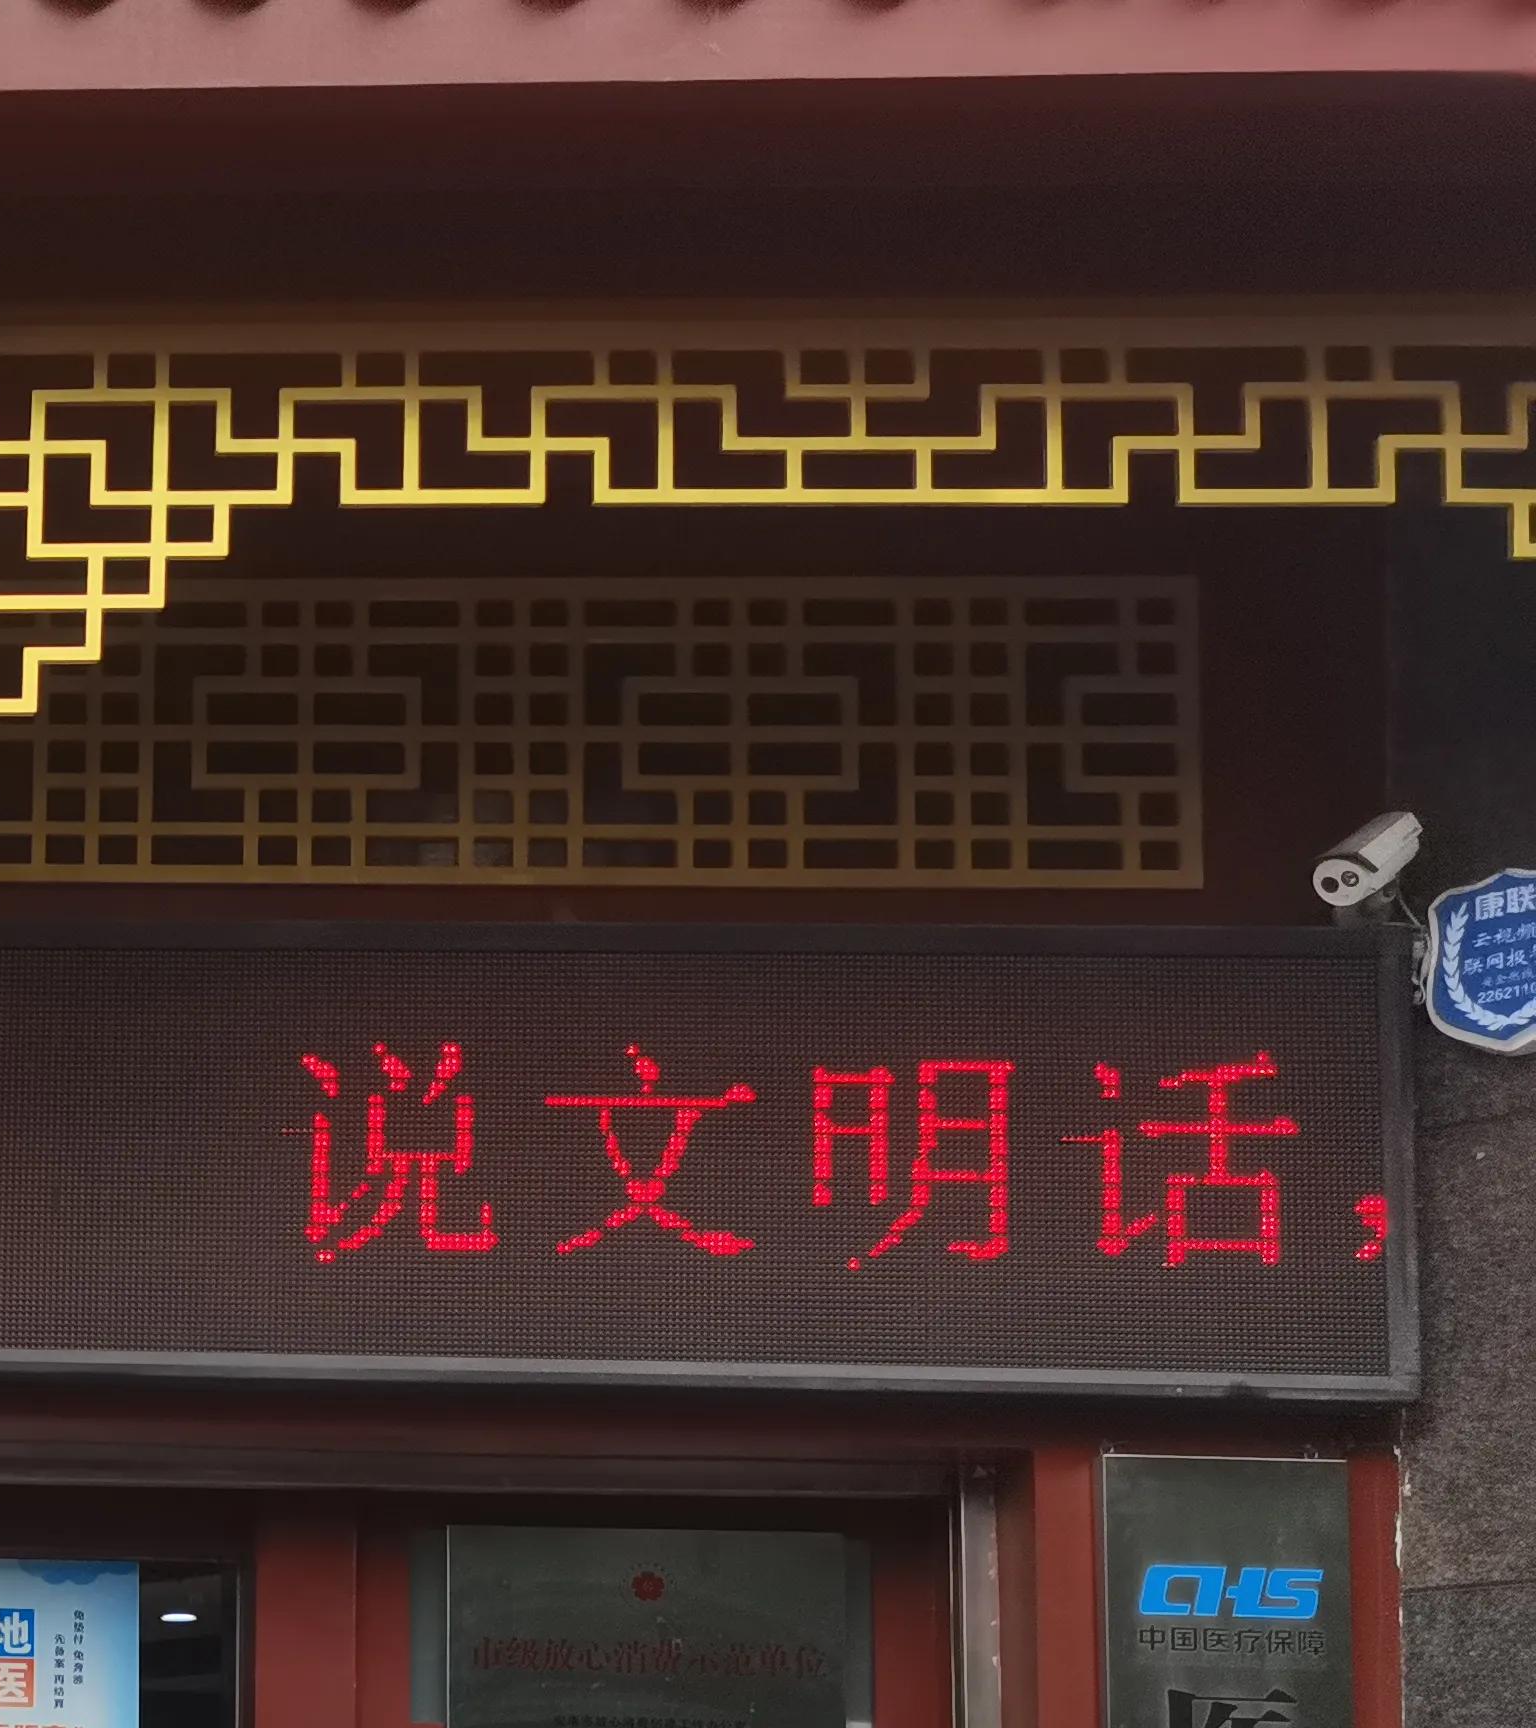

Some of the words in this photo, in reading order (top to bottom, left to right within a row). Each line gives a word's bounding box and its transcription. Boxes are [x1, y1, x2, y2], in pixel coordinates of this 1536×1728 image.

[1139, 1565, 1324, 1619] CHS
[1137, 1626, 1327, 1658] 中国医疗保障
